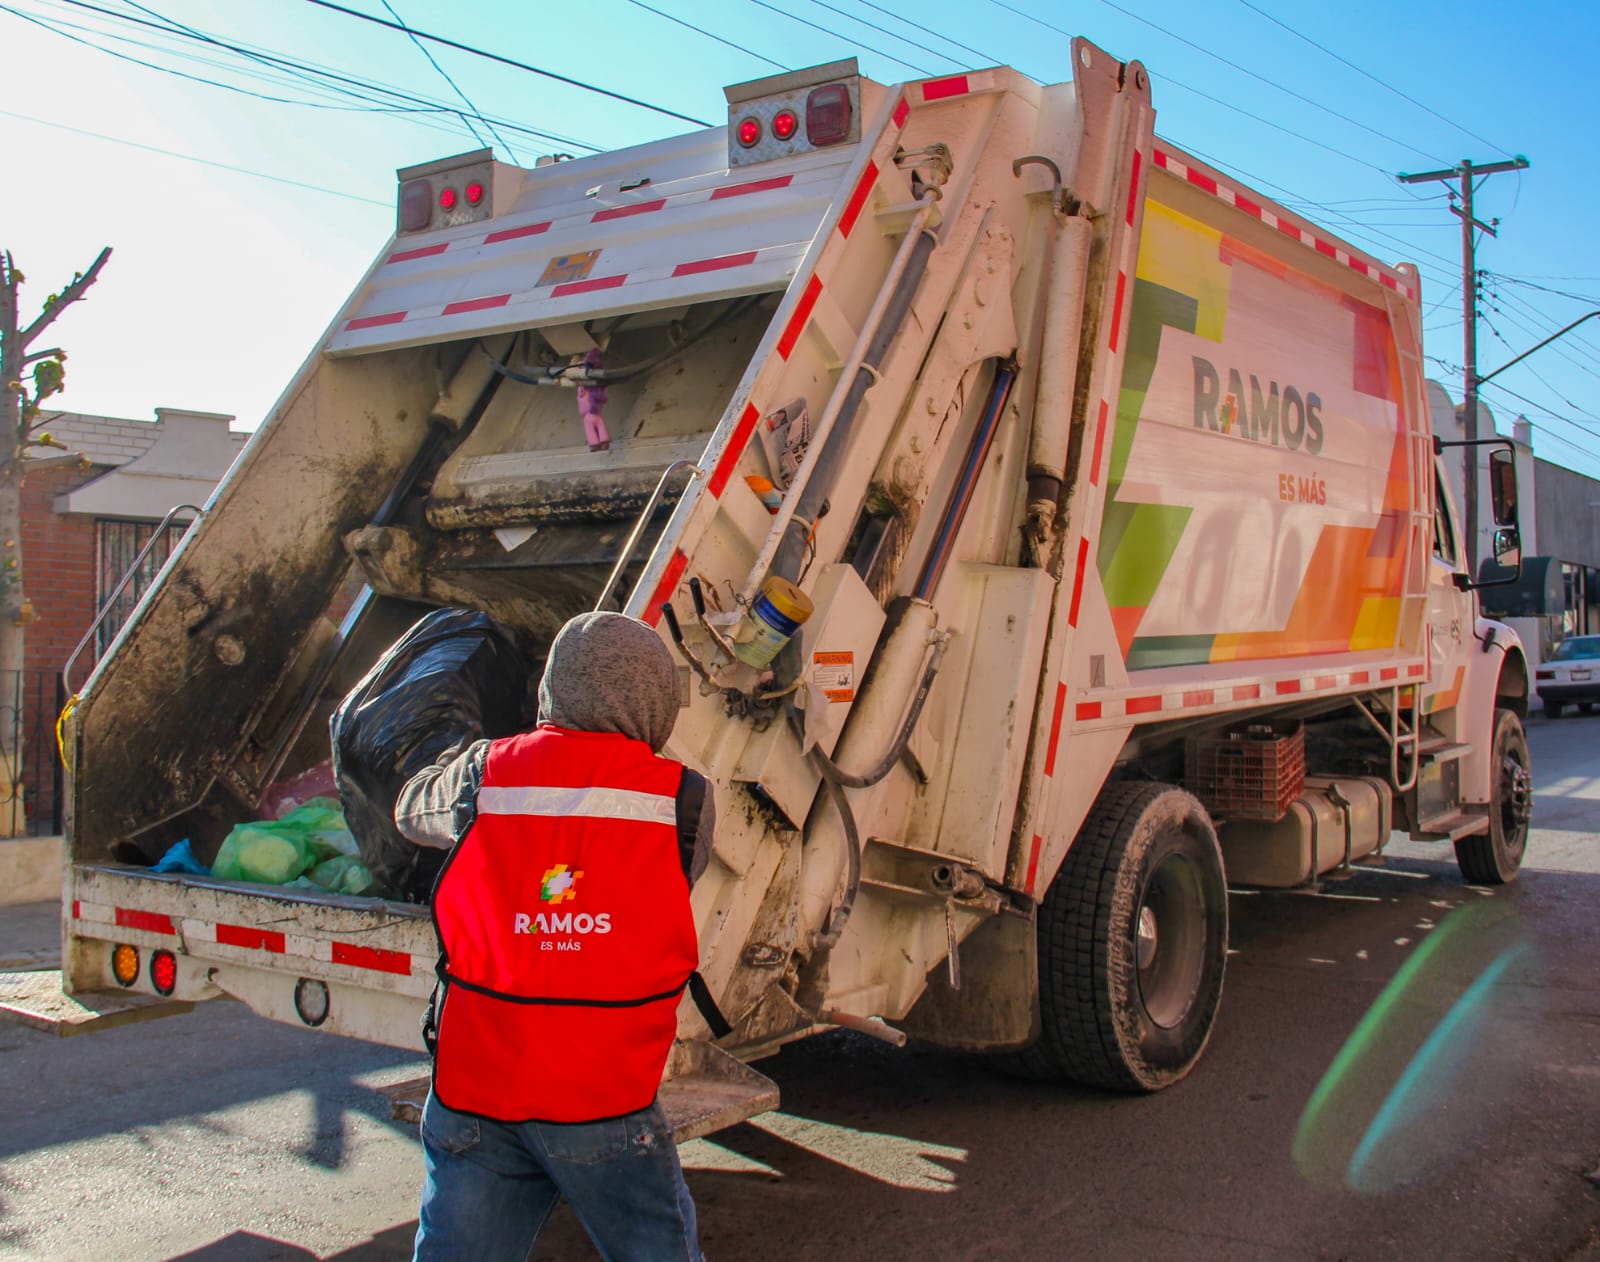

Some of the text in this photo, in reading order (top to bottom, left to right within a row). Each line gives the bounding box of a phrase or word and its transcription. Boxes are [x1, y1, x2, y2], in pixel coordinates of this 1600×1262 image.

[1191, 356, 1325, 456] RAMOS
[1279, 472, 1327, 506] ES MÁS
[514, 912, 612, 934] RAMOS
[540, 939, 582, 951] ES MÁS
